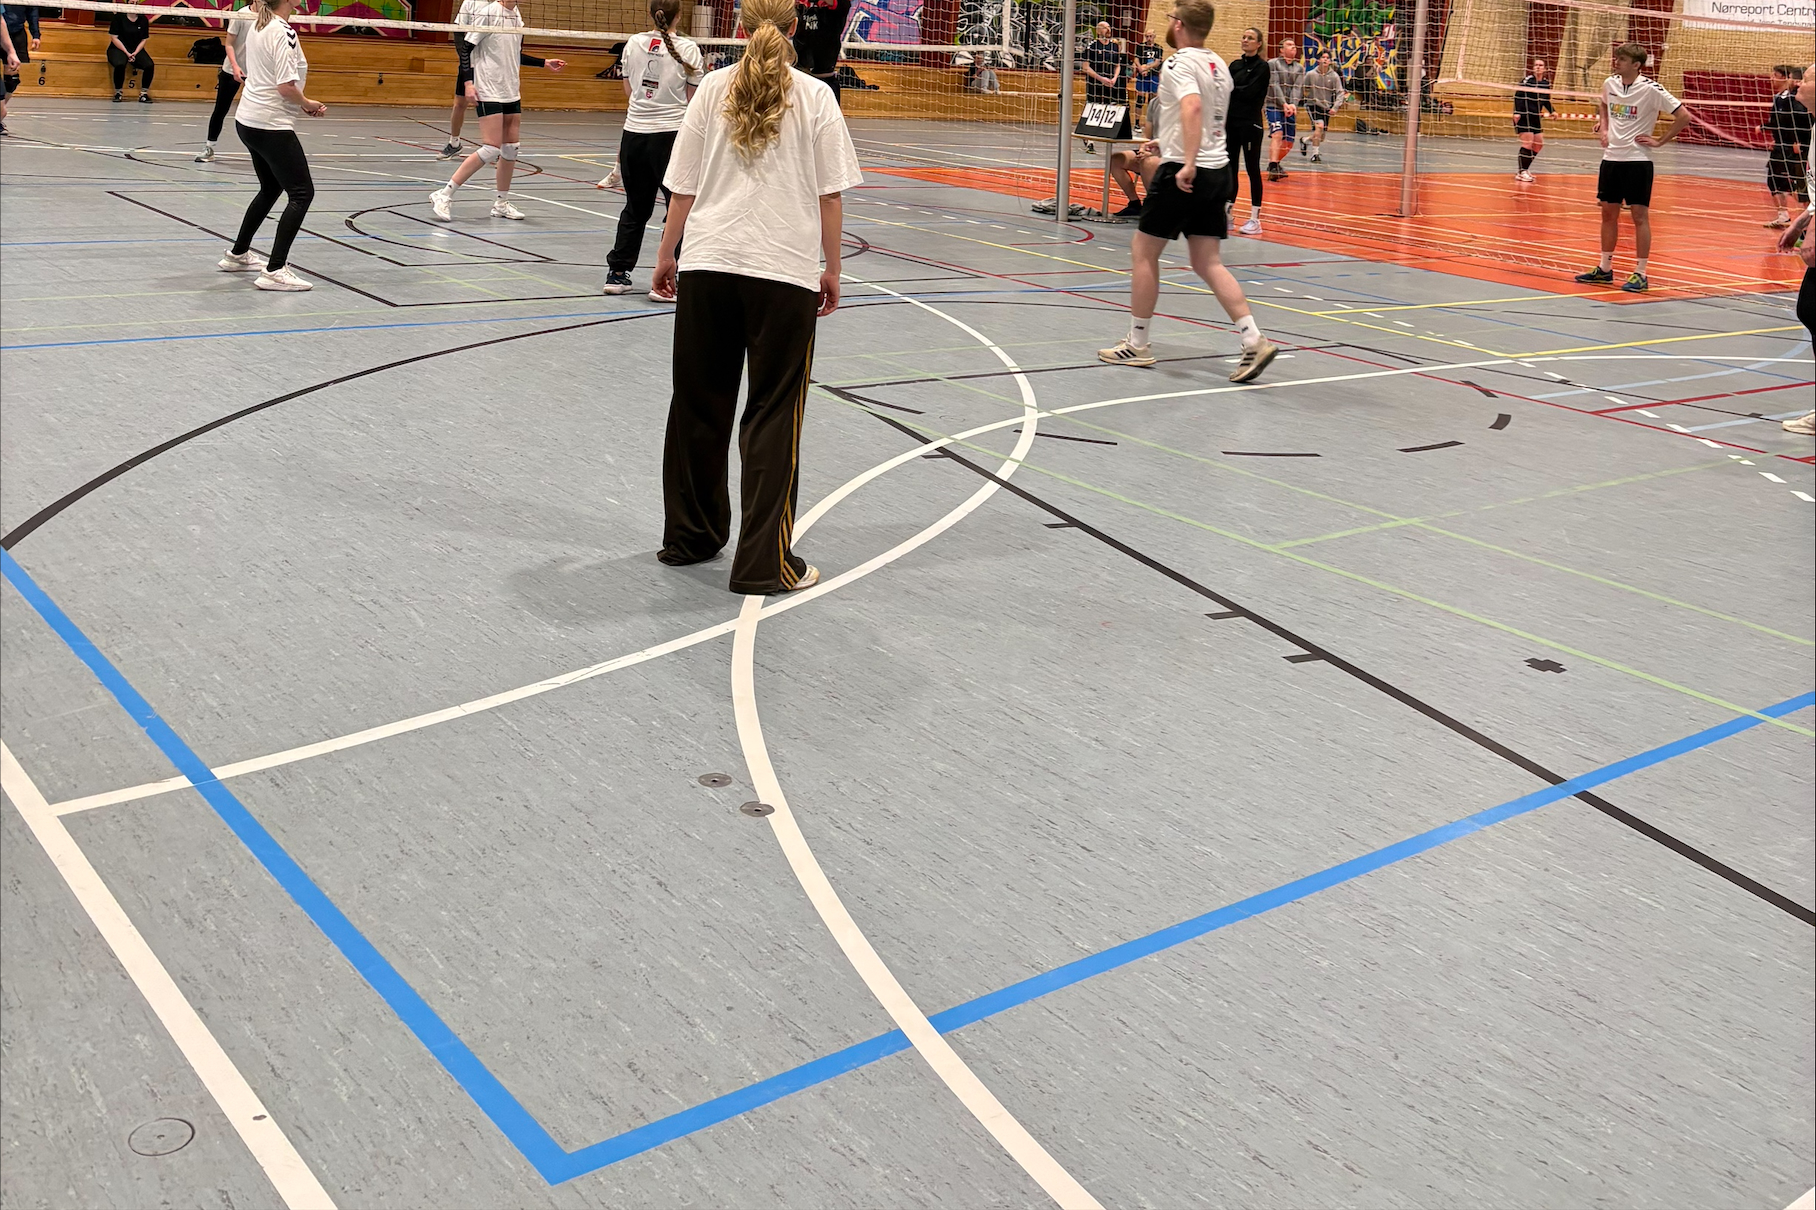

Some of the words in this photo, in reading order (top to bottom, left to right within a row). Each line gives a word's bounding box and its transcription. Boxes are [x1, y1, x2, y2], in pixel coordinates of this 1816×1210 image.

[1711, 1, 1775, 18] Nørreport
[38, 76, 46, 86] 6
[128, 80, 136, 89] 5
[1090, 108, 1102, 122] 14
[1104, 110, 1116, 124] 12
